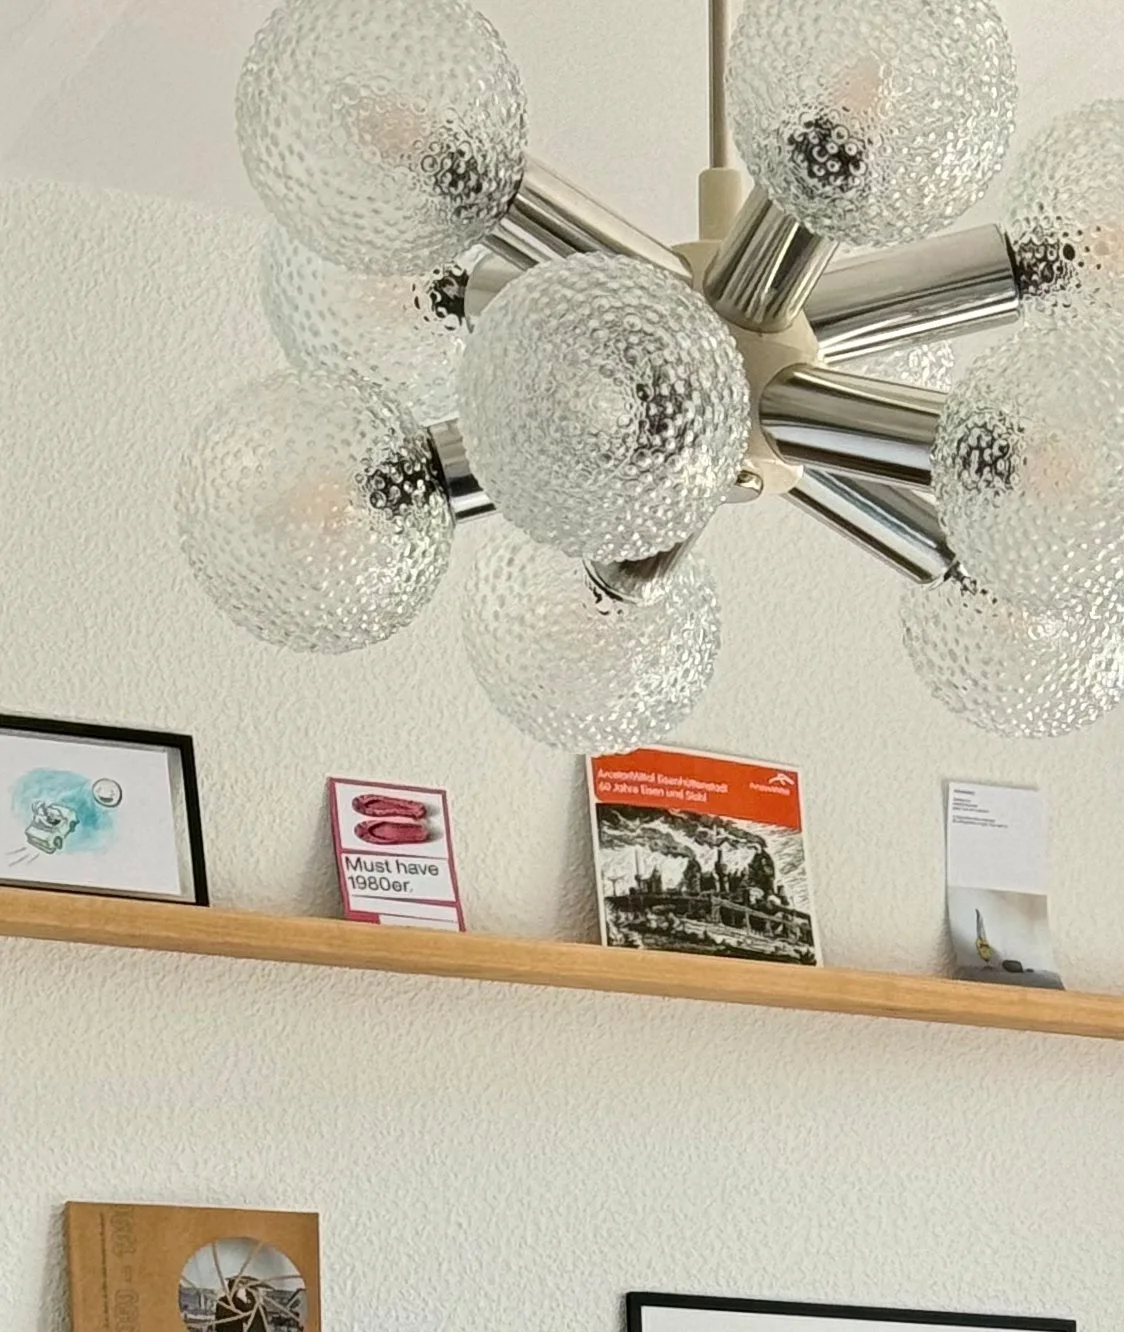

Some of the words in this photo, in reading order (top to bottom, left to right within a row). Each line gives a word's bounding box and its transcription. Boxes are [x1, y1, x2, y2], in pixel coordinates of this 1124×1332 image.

[345, 856, 392, 874] Must
[396, 860, 439, 876] have
[348, 875, 414, 892] 1980er.
